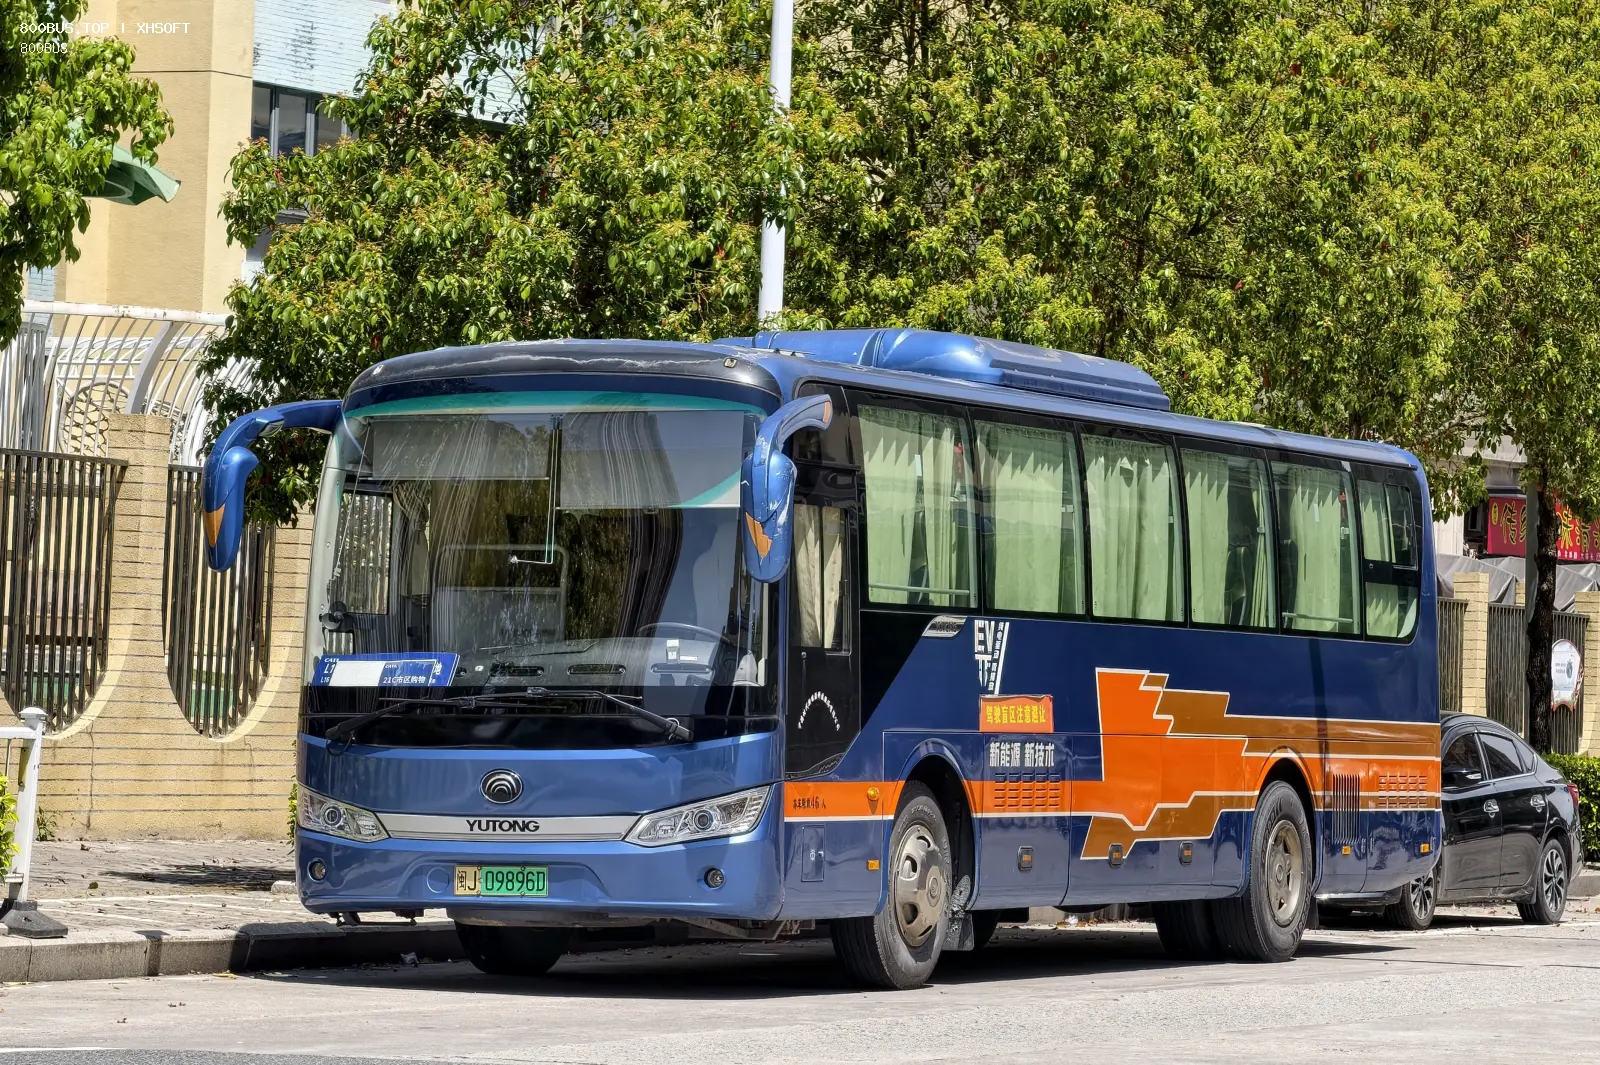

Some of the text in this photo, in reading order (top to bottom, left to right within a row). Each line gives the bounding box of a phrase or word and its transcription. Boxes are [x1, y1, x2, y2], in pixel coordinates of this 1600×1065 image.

[985, 704, 1046, 724] 驾驶盲区注意避让
[990, 741, 1055, 767] 新能源 新技术
[466, 819, 540, 833] YUTONG
[456, 870, 546, 892] 闽J 09896D
